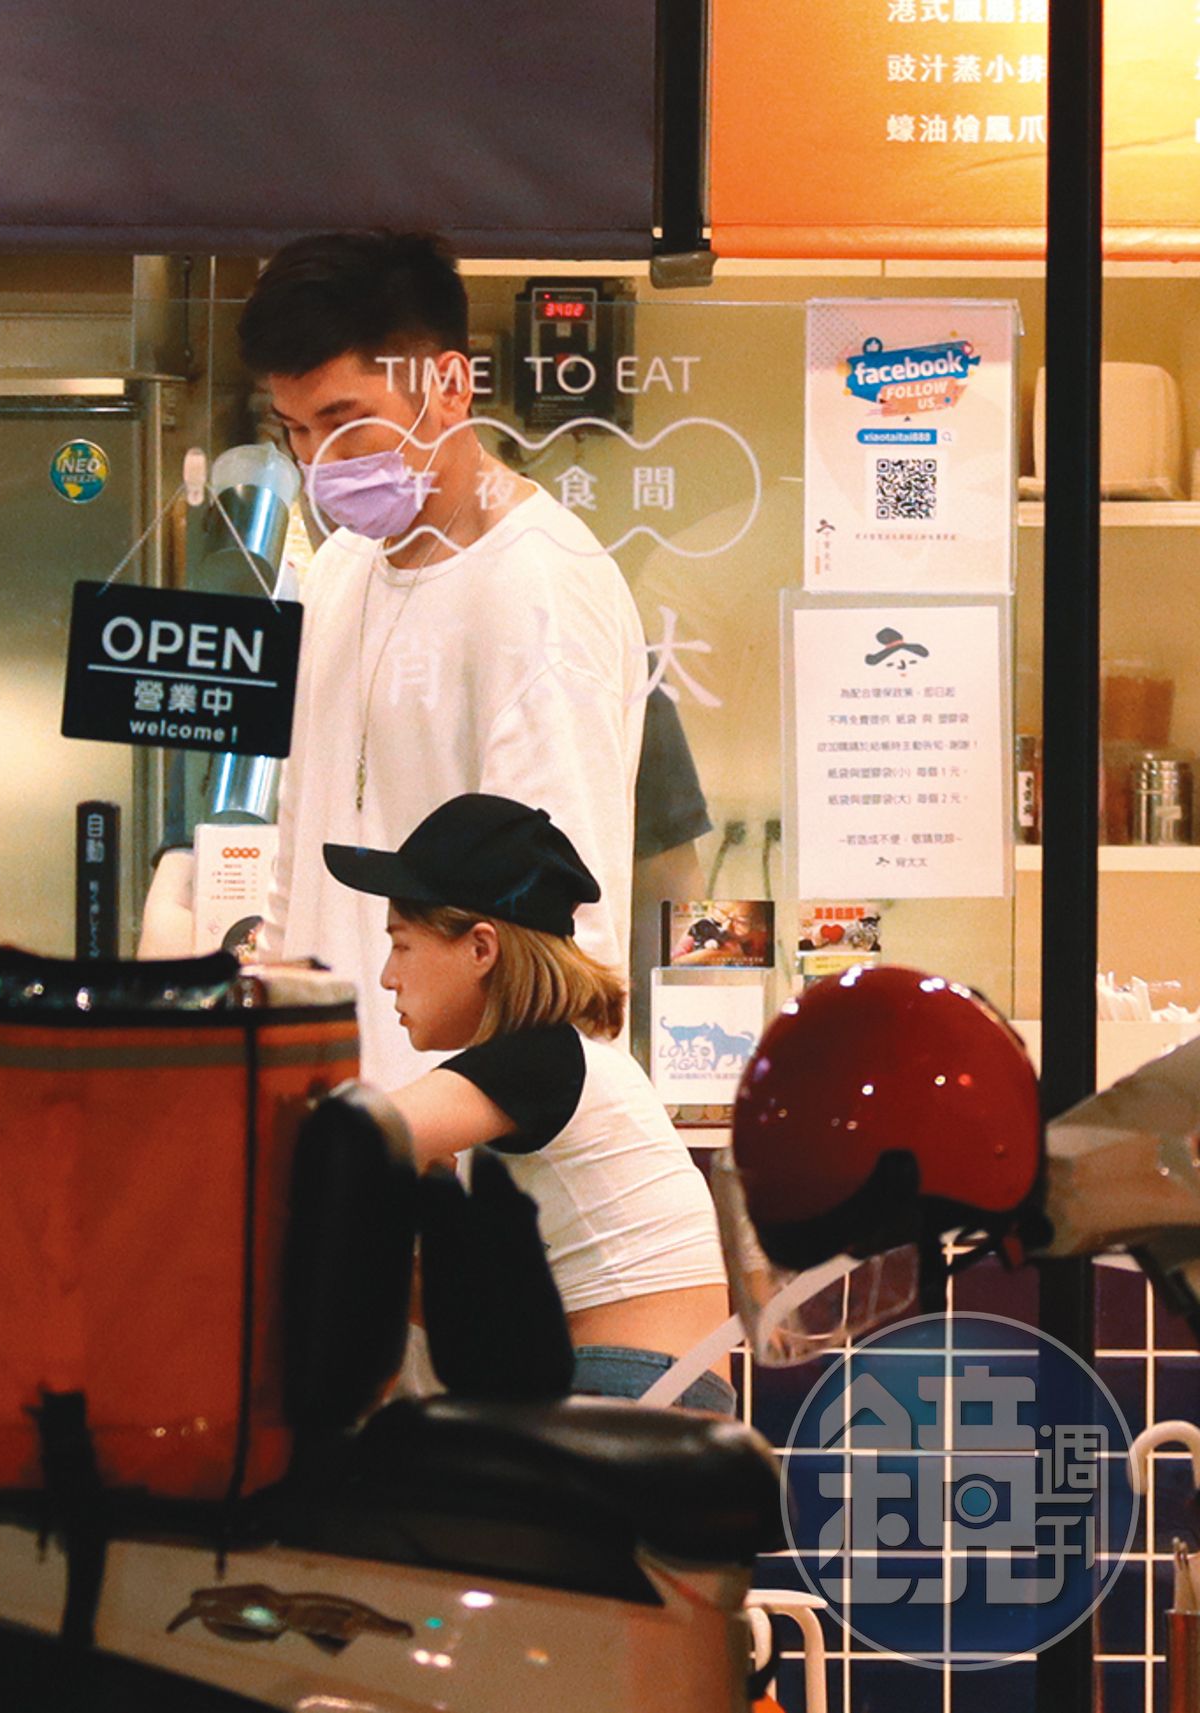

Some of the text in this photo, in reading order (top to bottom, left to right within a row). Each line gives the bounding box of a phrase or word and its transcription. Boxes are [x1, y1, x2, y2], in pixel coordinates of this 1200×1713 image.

[375, 355, 701, 395] TIME TO EAT
[854, 350, 965, 386] facebook
[885, 380, 949, 400] FOLLOW
[916, 398, 937, 410] US
[59, 456, 100, 474] NEO
[398, 465, 676, 511] 午夜食間
[101, 615, 265, 674] OPEN
[133, 679, 234, 717] 營業中
